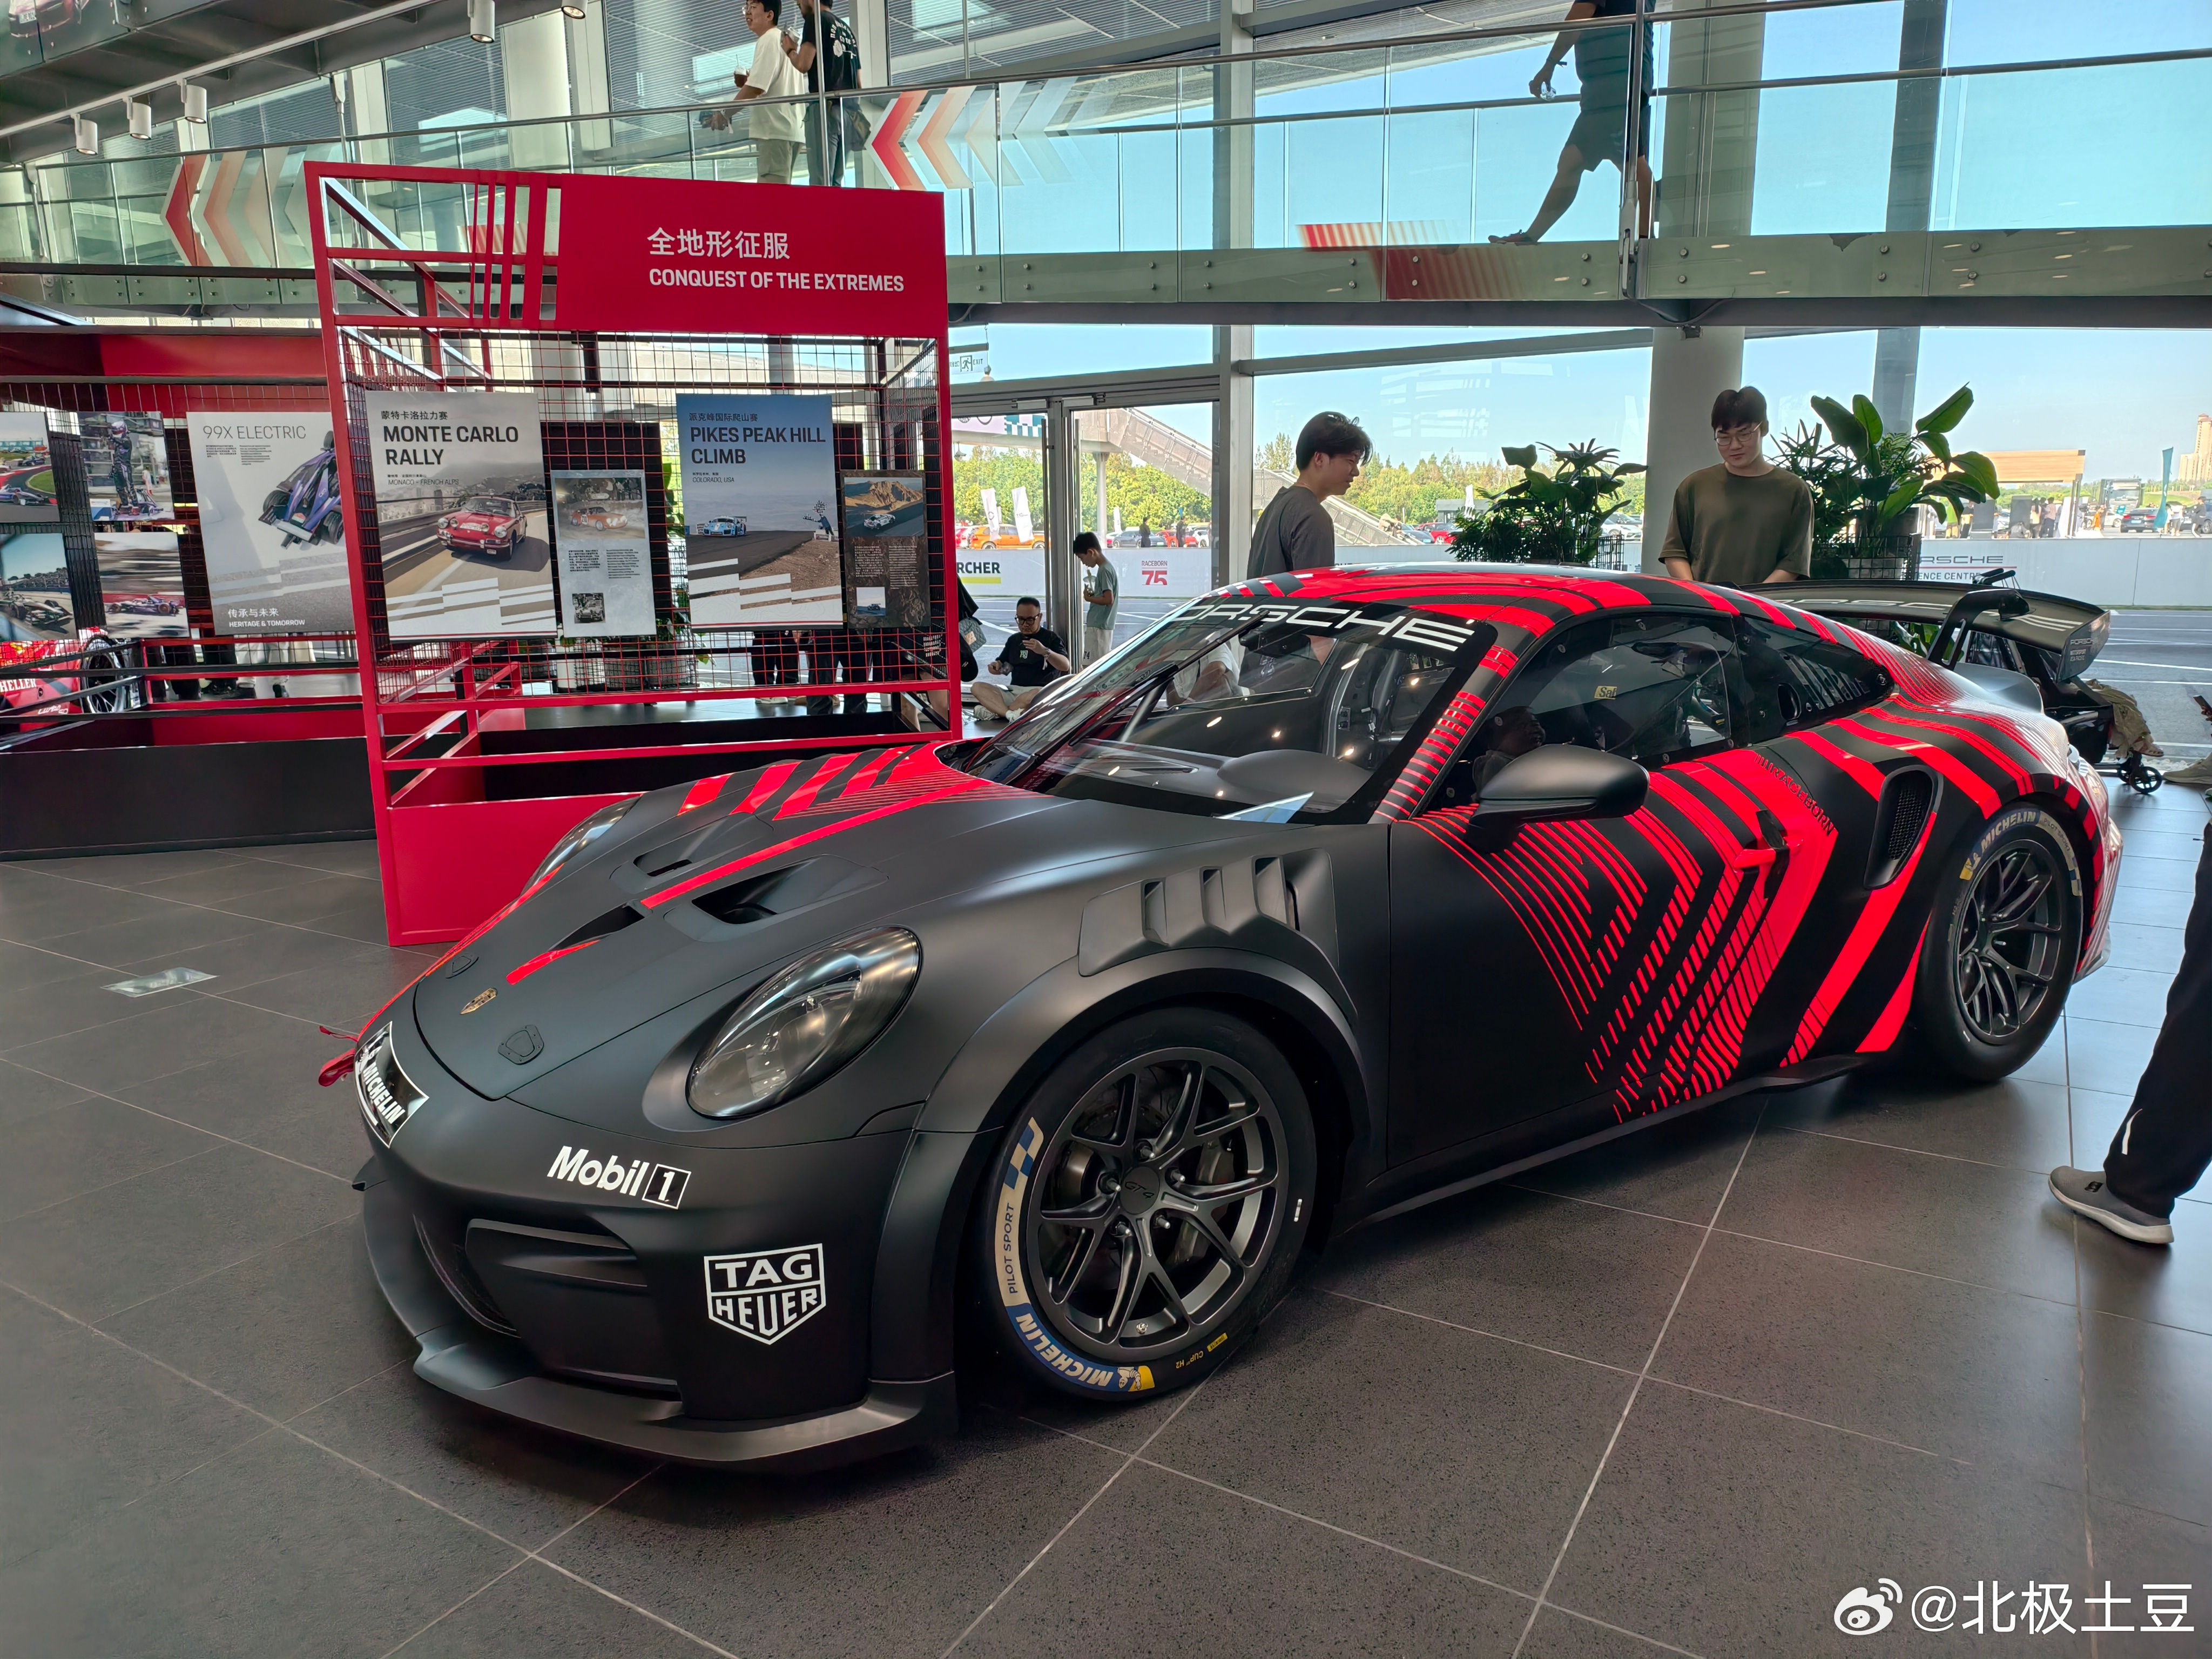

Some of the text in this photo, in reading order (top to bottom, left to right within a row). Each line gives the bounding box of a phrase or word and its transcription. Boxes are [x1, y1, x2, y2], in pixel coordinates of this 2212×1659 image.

[647, 227, 790, 259] 全地形征服
[649, 268, 904, 292] CONQUEST OF THE EXTREMES
[381, 411, 448, 420] 蒙特卡洛拉力赛
[689, 413, 758, 422] 派克峰国际爬山赛
[203, 426, 306, 439] 99X ELECTRIC
[383, 426, 519, 442] MONTE CARLO
[691, 427, 826, 442] PIKES PEAK HILL
[385, 449, 444, 465] RALLY
[691, 448, 746, 464] CLIMB
[1142, 570, 1168, 585] 75
[228, 608, 279, 618] 传承与未来
[1981, 811, 2036, 853] MICHELIN
[363, 1061, 406, 1124] MICHELIN
[547, 1145, 676, 1202] Mobil 1
[1003, 1203, 1018, 1294] PILOT SPORT
[715, 1253, 813, 1289] TAG
[716, 1288, 818, 1337] HEUER
[1015, 1313, 1114, 1387] MICHELIN
[1176, 1359, 1184, 1369] H2
